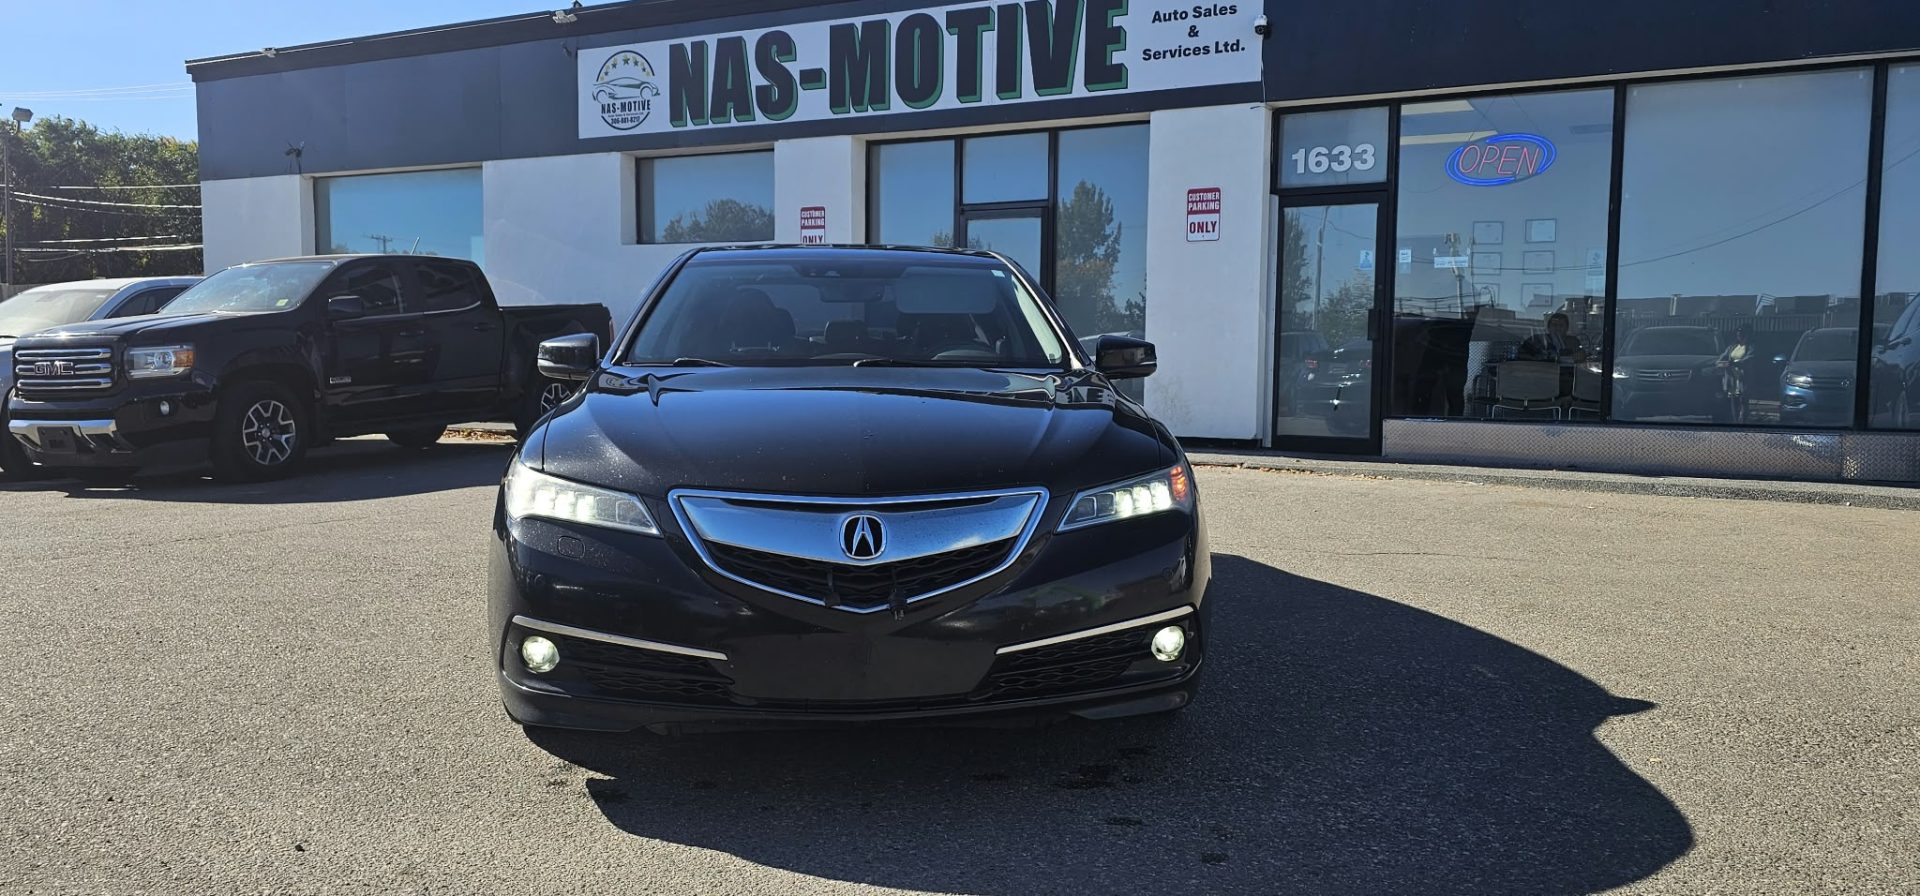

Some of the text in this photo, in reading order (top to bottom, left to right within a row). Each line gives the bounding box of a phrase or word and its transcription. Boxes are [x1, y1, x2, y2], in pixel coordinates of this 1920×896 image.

[1152, 4, 1238, 24] Auto Sales
[1188, 25, 1200, 38] &
[1142, 39, 1246, 61] Services Ltd.
[669, 0, 1128, 128] NAS-MOTIVE
[601, 99, 651, 115] NAS-MOTIVE
[1291, 143, 1375, 174] 1633
[1459, 144, 1540, 176] OPEN
[1188, 192, 1220, 202] CUSTOMER
[1188, 201, 1220, 211] PARKING
[1189, 220, 1217, 234] ONLY
[34, 360, 74, 376] GMC
